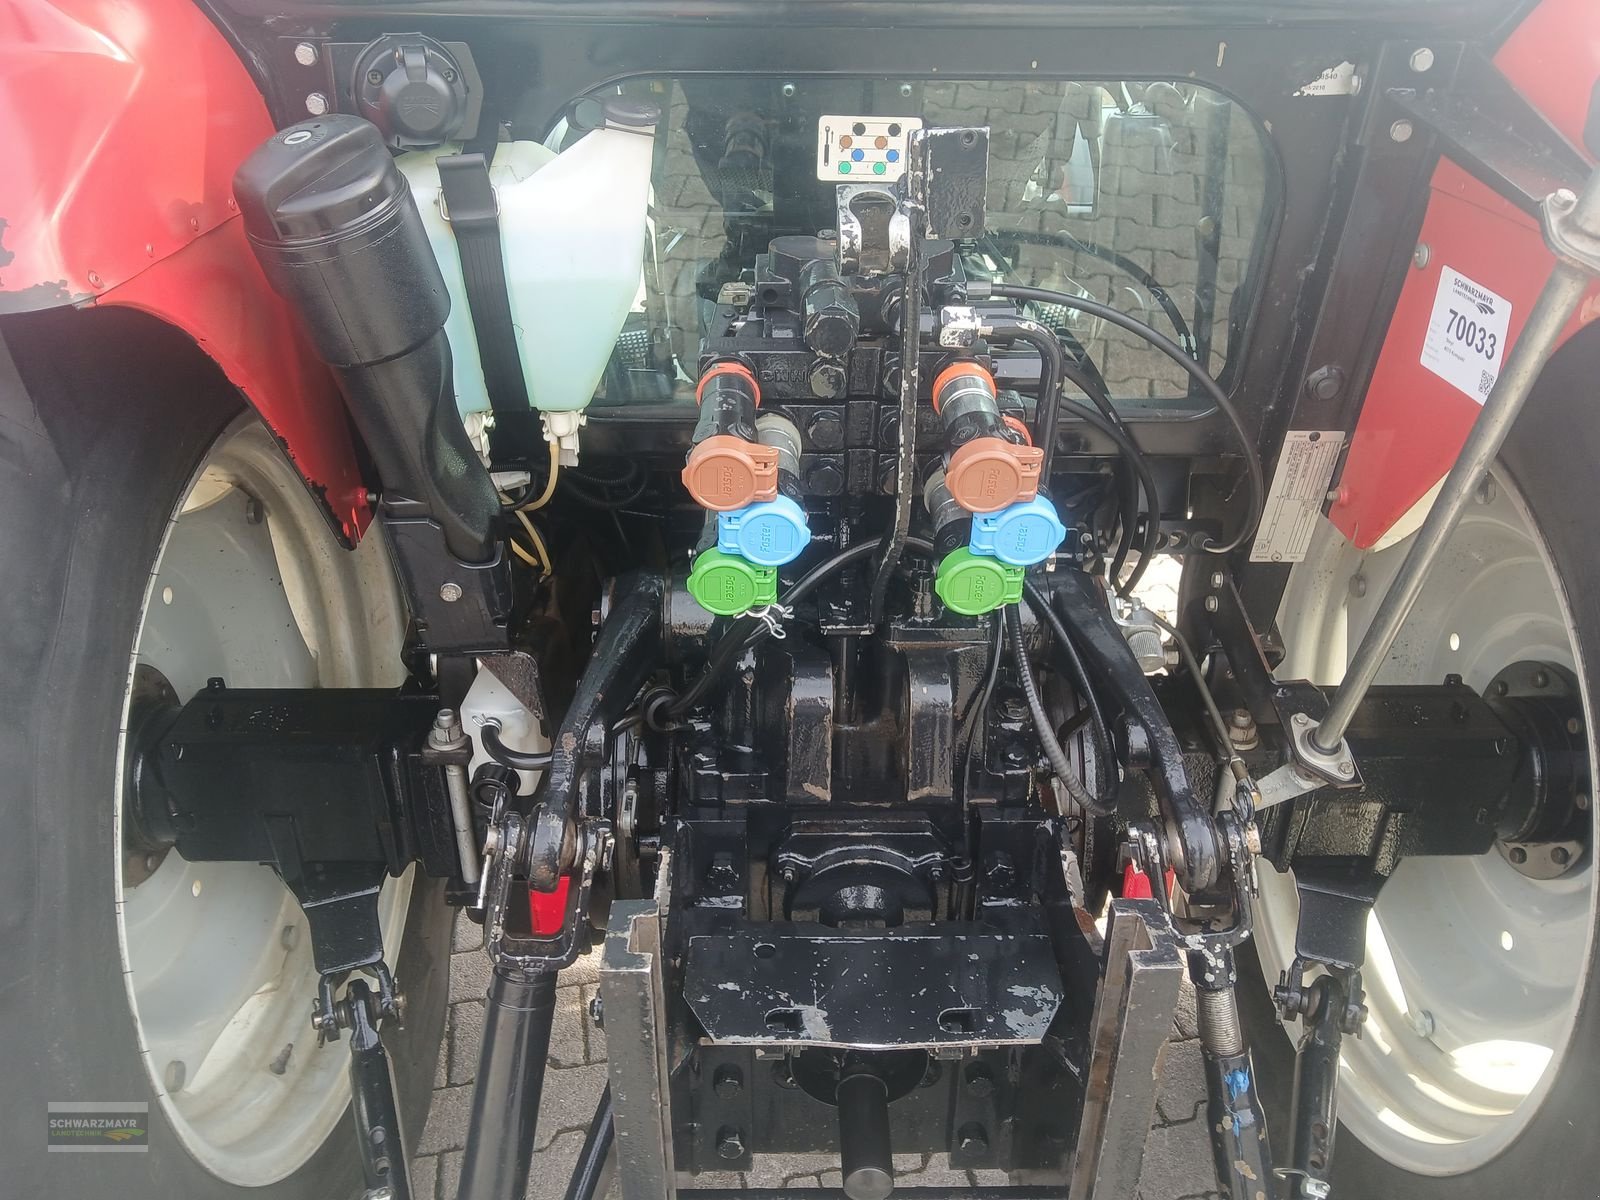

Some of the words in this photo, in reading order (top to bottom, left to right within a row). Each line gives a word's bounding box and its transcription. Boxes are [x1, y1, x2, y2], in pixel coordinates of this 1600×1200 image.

[1453, 278, 1494, 306] SCHWARZMAYR
[1446, 308, 1497, 360] 70033
[723, 466, 734, 496] Faster
[986, 468, 1000, 499] Faster
[760, 523, 772, 553] Faster
[1015, 522, 1028, 553] Faster
[725, 575, 736, 603] Faster
[975, 574, 986, 602] Faster
